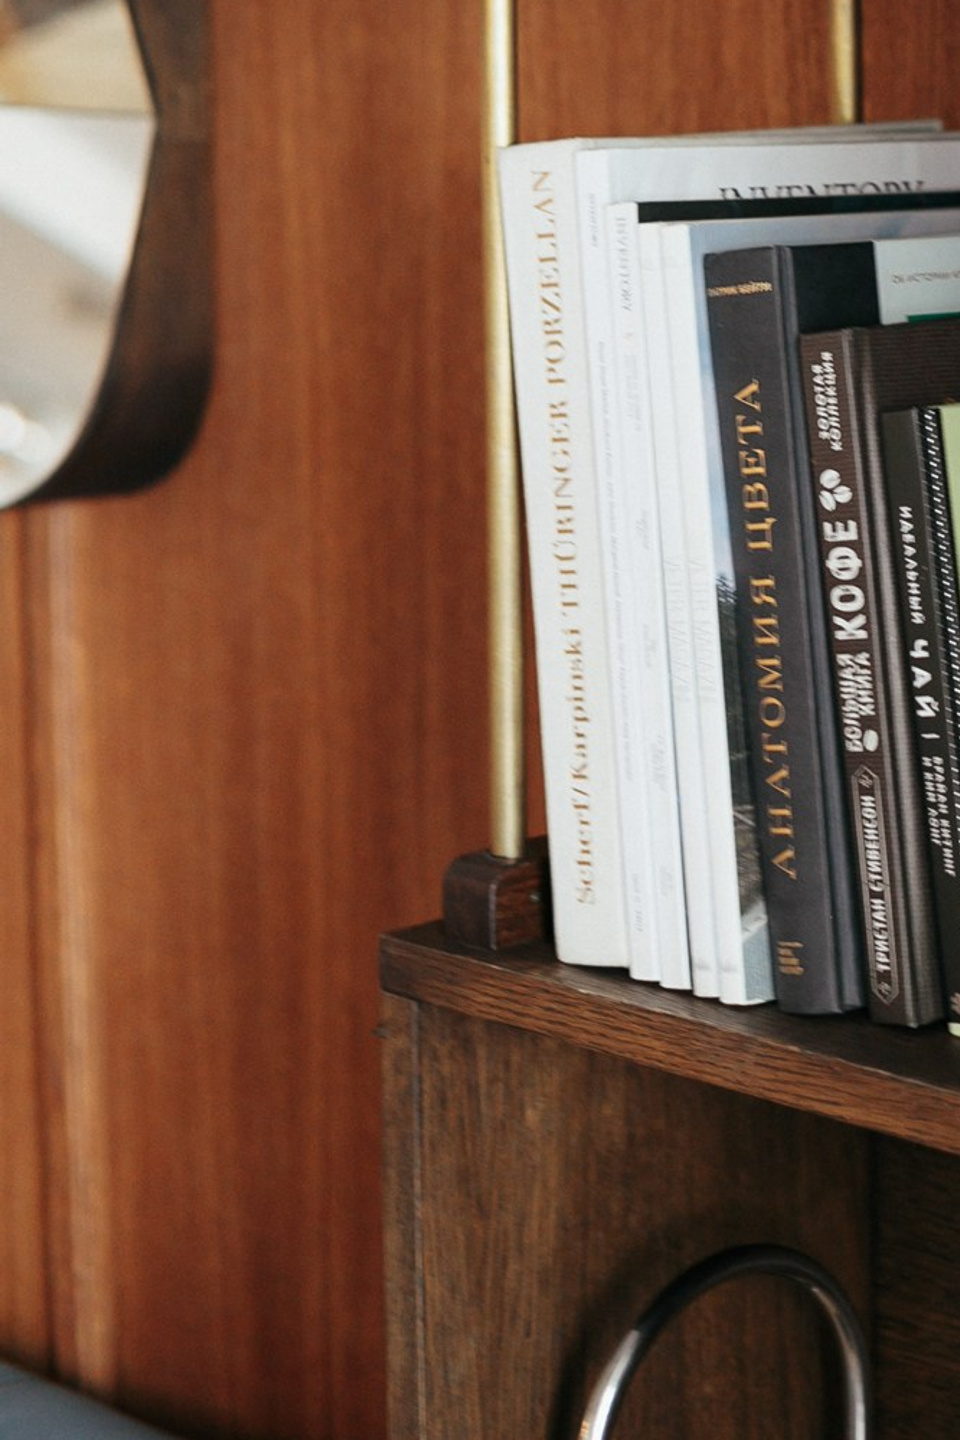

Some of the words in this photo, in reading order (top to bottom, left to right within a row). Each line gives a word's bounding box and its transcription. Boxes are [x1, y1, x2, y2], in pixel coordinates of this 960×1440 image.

[531, 169, 566, 389] PORZELLAN
[819, 351, 842, 451] КОЛЛЕКЦИЯ
[547, 402, 579, 614] THÜRINGER
[733, 379, 778, 552] ЦВЕТА
[825, 518, 868, 641] КОФЕ
[899, 505, 925, 626] ИДЕАЛЬНЫЙ
[749, 575, 797, 880] АНАТОМИЯ
[838, 652, 866, 753] БОЛЬШАЯ
[855, 651, 876, 717] КНИГА
[910, 639, 940, 719] ЧАЙ
[564, 628, 596, 905] Scherf/Karpinski
[861, 794, 886, 894] СТИВЕНСОН
[873, 897, 892, 973] ТРИСТАН
